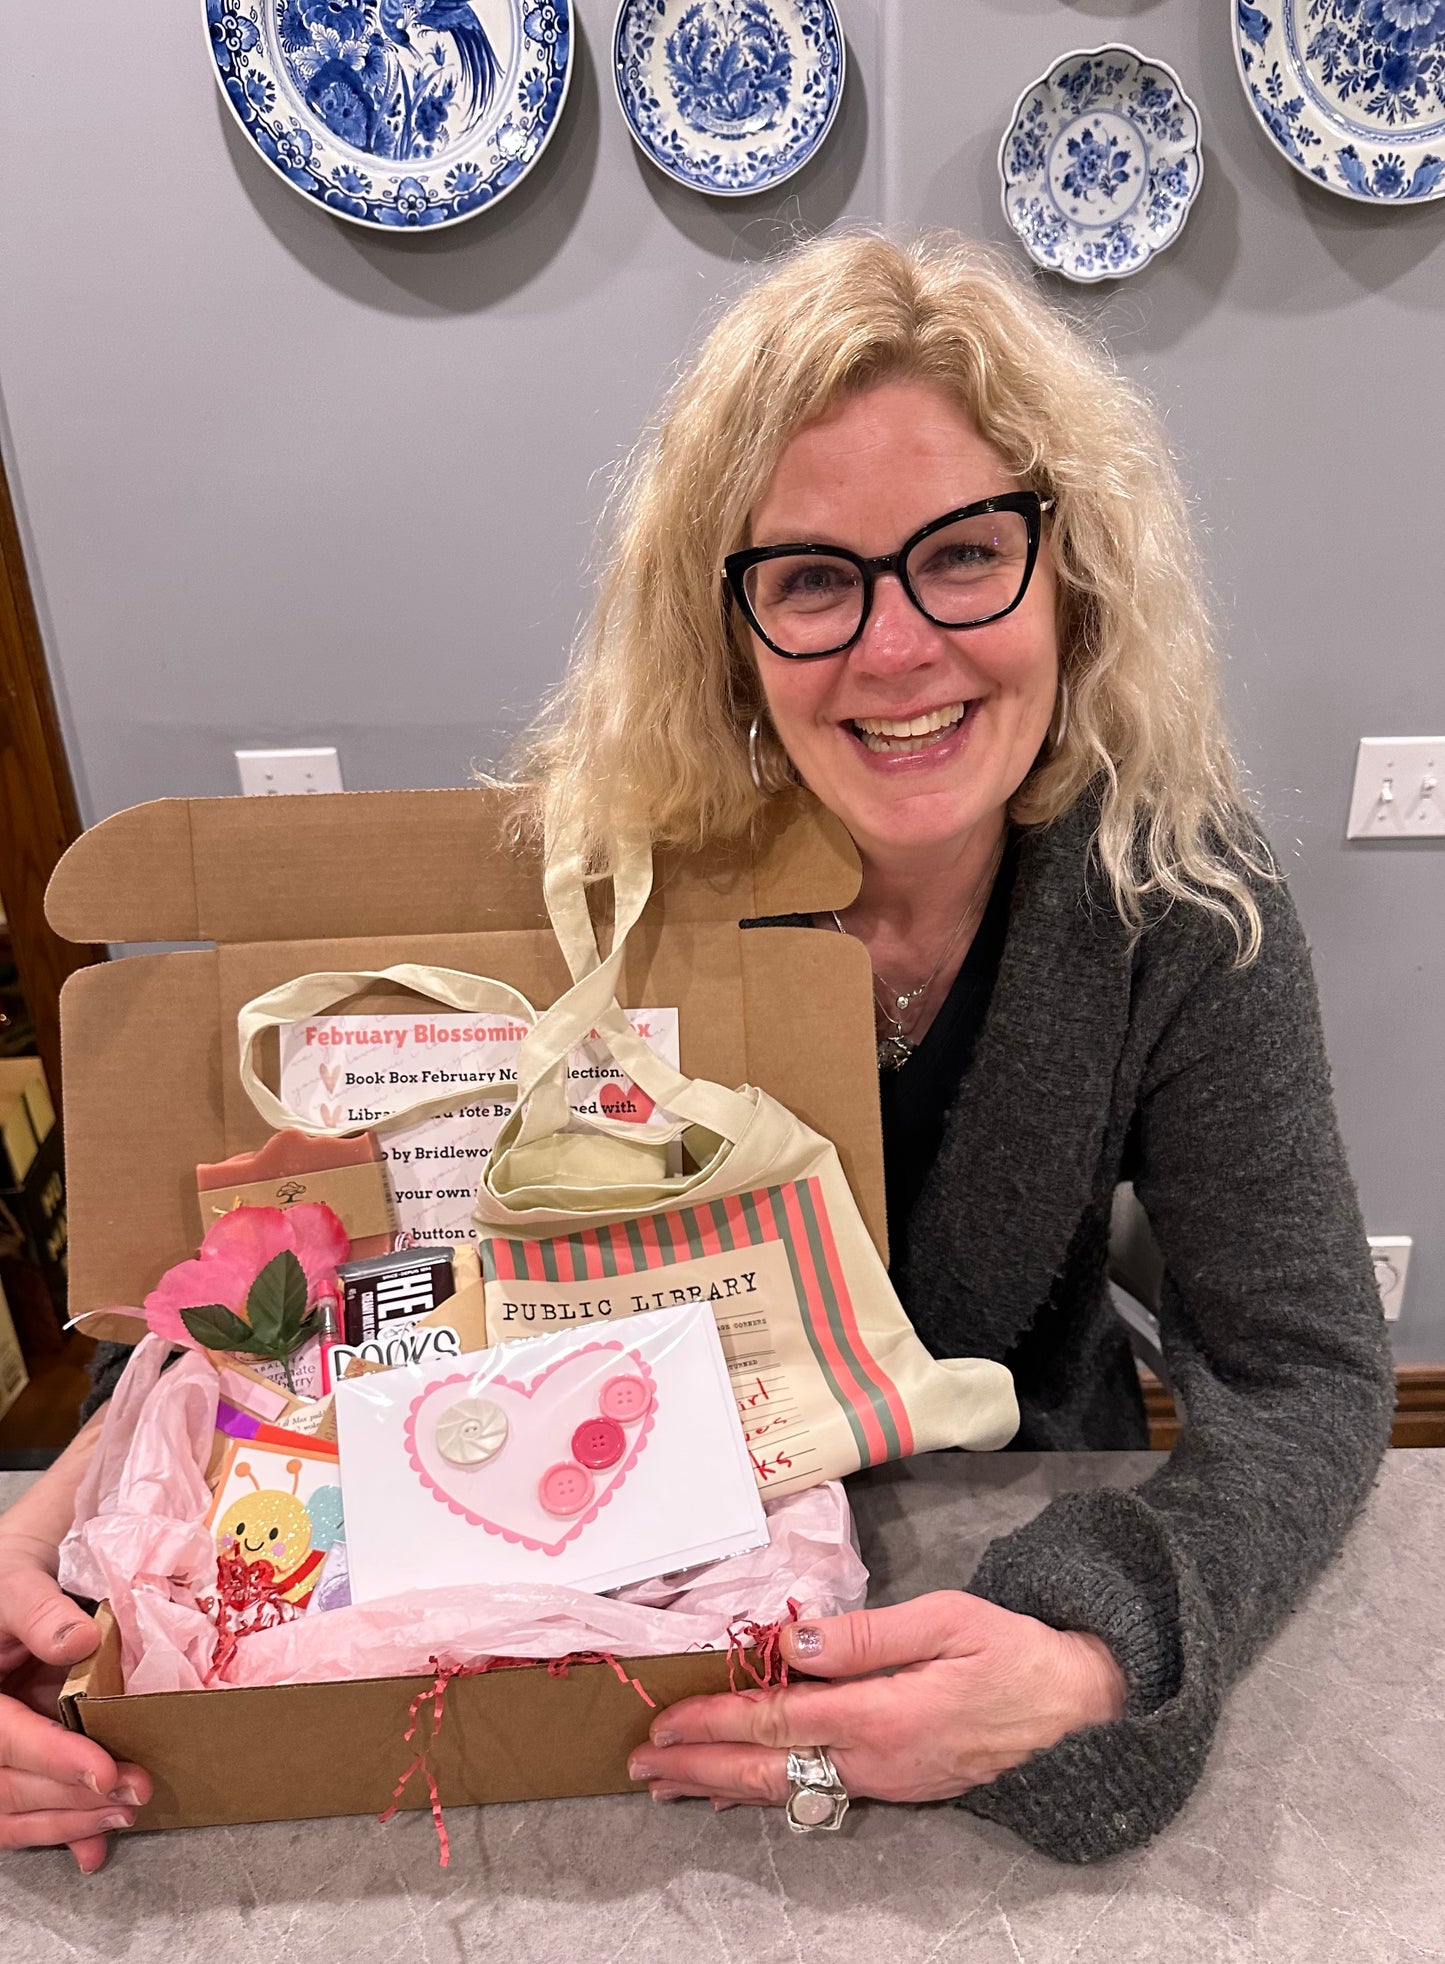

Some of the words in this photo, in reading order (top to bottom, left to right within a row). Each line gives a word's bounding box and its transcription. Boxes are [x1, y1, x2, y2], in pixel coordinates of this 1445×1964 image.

[305, 1026, 408, 1048] February
[414, 1022, 529, 1044] Blossomin
[345, 1072, 385, 1085] Book
[389, 1072, 418, 1085] Box
[421, 1070, 496, 1083] February
[499, 1068, 518, 1081] No
[567, 1066, 624, 1079] lection.
[348, 1108, 396, 1121] Libra
[494, 1104, 512, 1117] Ba
[601, 1101, 637, 1114] with
[392, 1148, 411, 1163] by
[415, 1146, 492, 1159] Bridlewo
[395, 1189, 433, 1203] your
[436, 1189, 471, 1199] own
[412, 1228, 465, 1240] button
[502, 1299, 612, 1321] PUBLIC
[631, 1272, 757, 1313] LIBRARY
[728, 1360, 758, 1370] TURNED
[738, 1377, 769, 1411] irl
